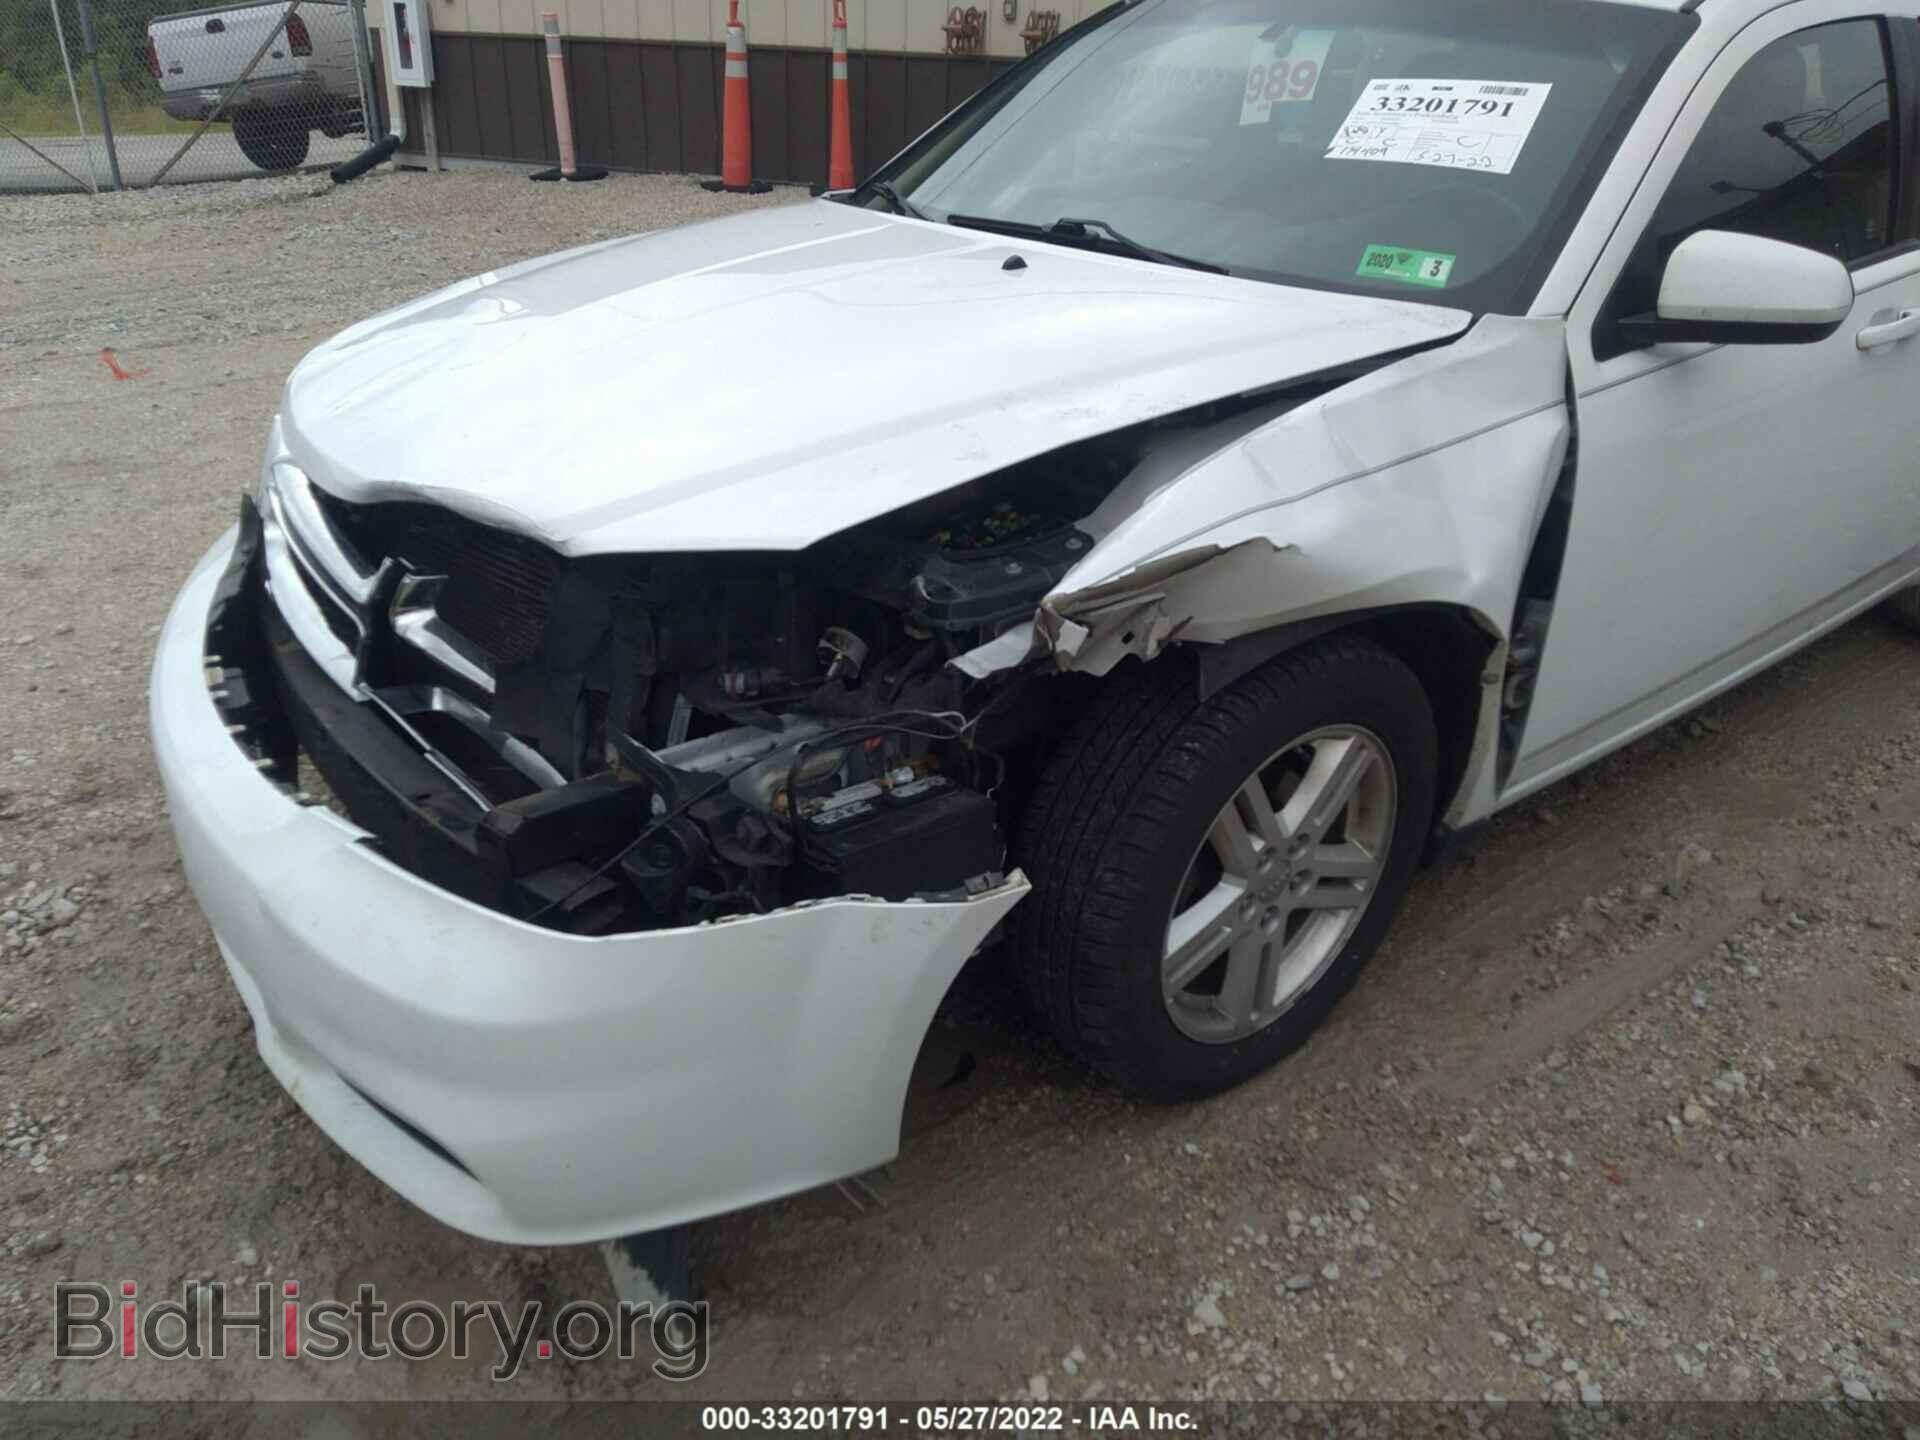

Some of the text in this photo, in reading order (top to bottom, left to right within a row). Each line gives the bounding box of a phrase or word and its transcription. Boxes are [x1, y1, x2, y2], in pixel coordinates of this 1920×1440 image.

[1247, 61, 1317, 104] 989
[1370, 96, 1514, 117] 33201791
[1430, 260, 1442, 277] 3
